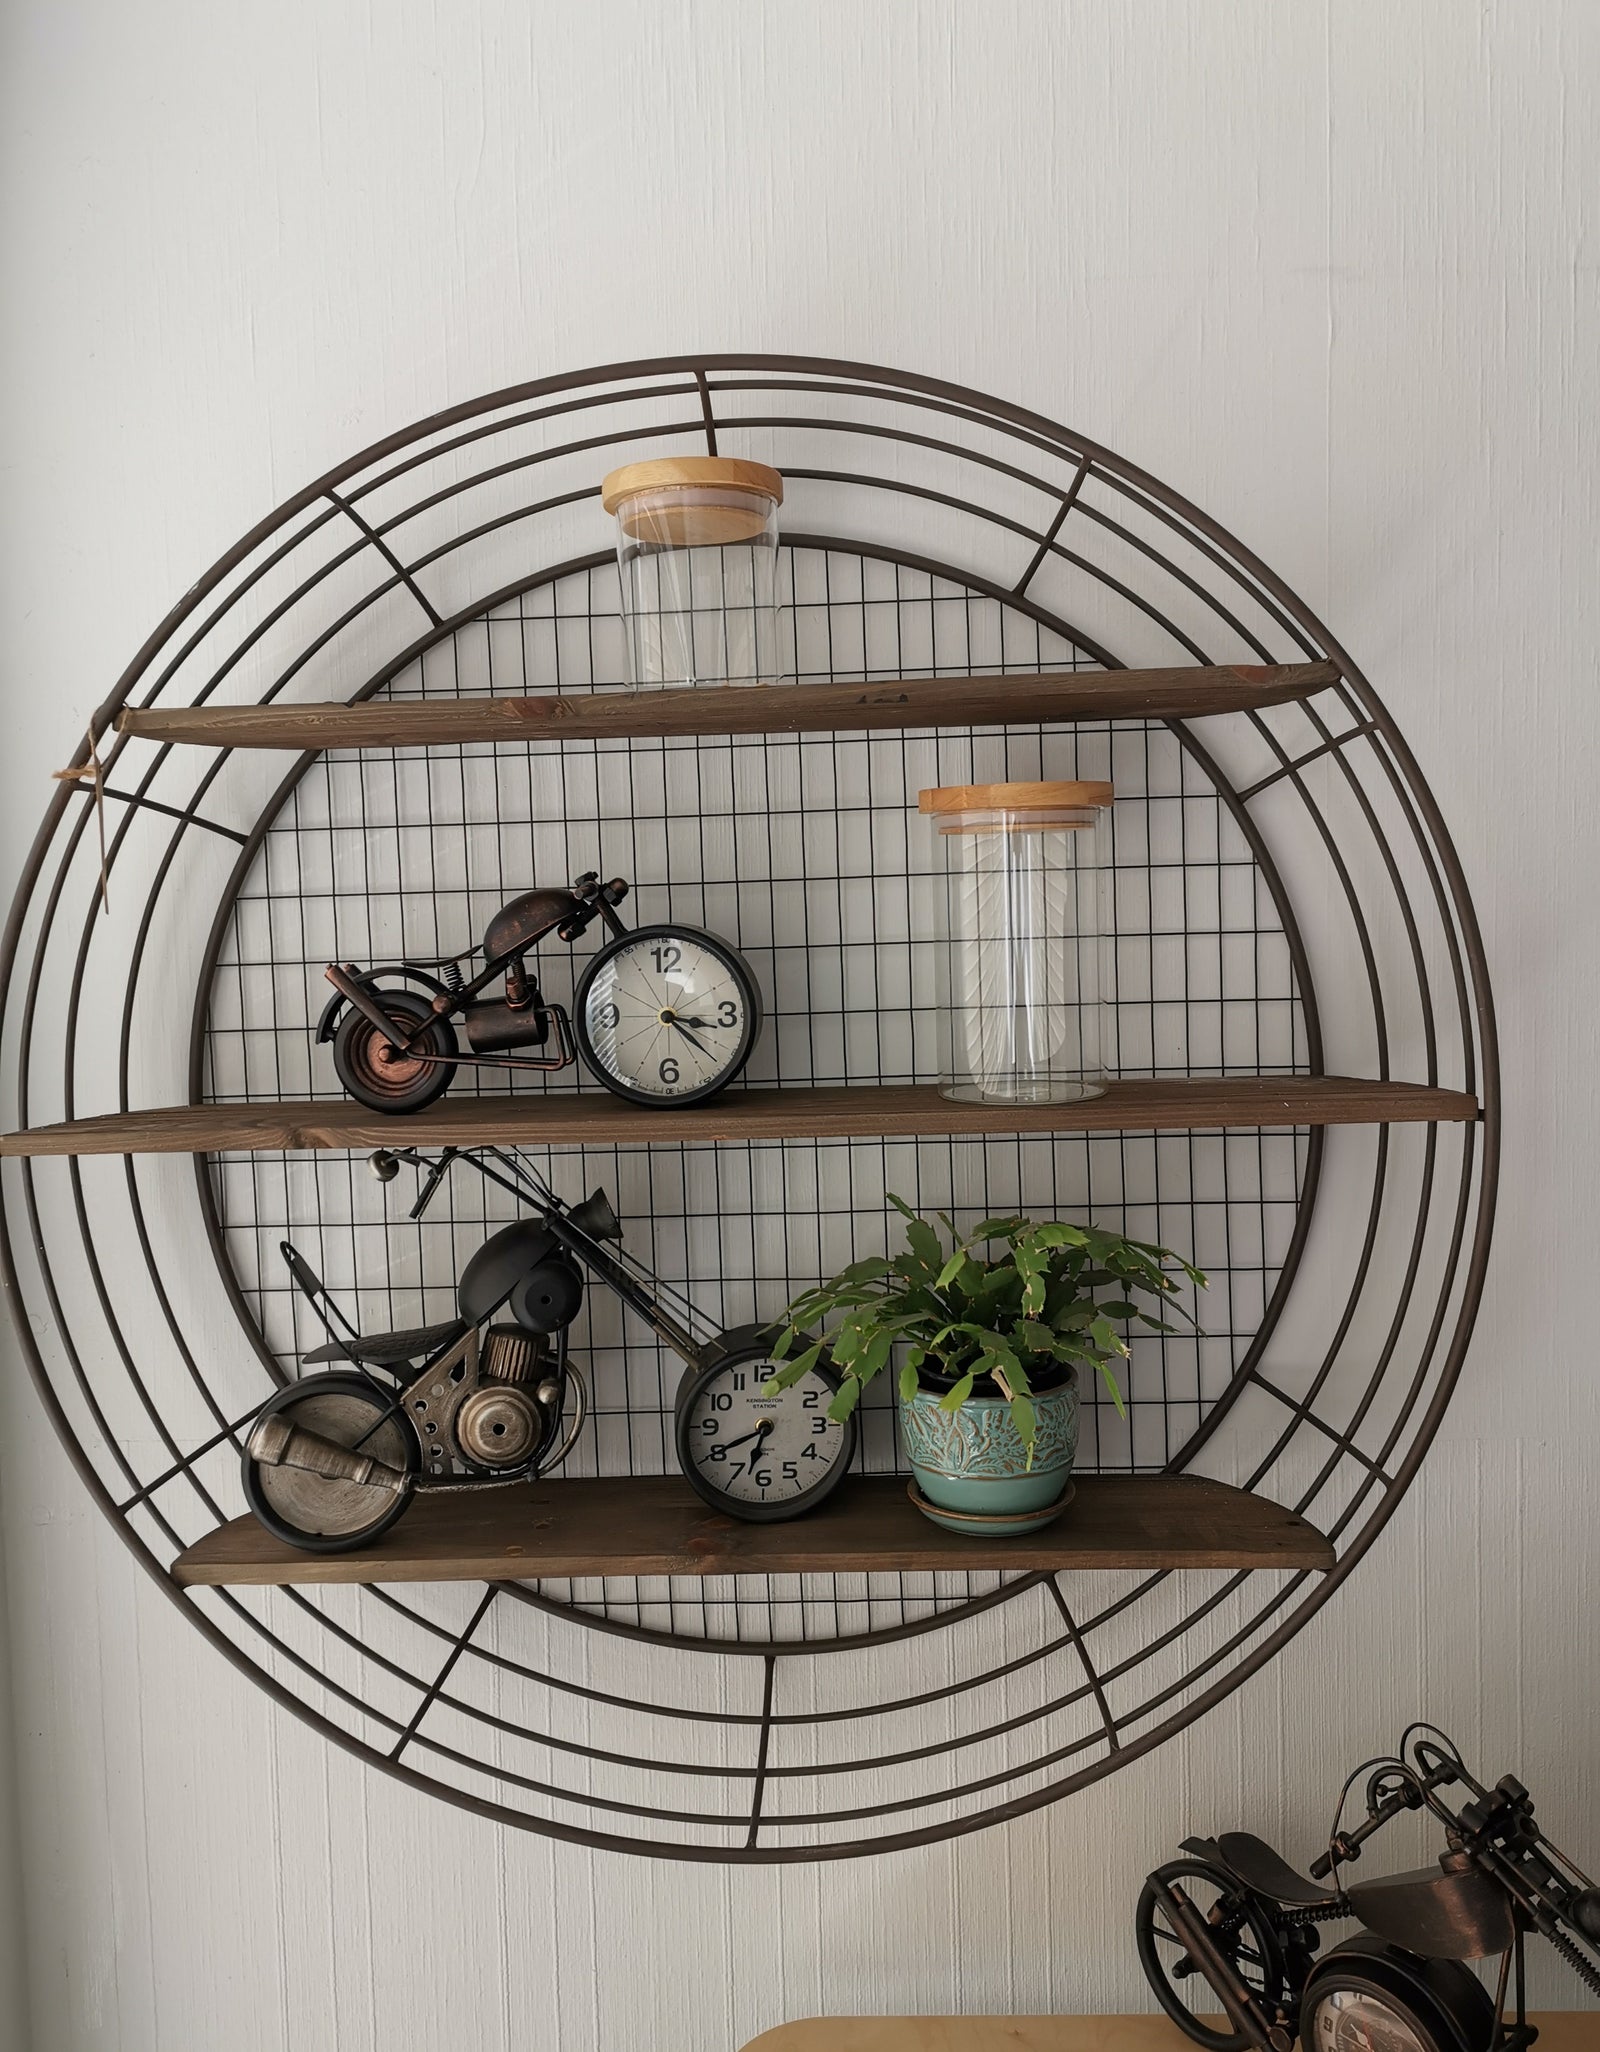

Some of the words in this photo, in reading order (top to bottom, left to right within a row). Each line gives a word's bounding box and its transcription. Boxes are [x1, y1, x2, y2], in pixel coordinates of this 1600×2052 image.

[650, 946, 682, 973] 12
[599, 1002, 620, 1029] 9
[717, 1001, 737, 1028] 3
[659, 1057, 680, 1085] 6
[733, 1373, 745, 1390] 11
[754, 1365, 776, 1382] 12
[711, 1393, 732, 1411] 10
[803, 1391, 819, 1408] 2
[702, 1418, 719, 1436] 9
[812, 1416, 827, 1434] 3
[710, 1444, 727, 1462] 8
[801, 1443, 817, 1460] 4
[730, 1462, 746, 1480] 7
[755, 1469, 772, 1487] 6
[782, 1461, 798, 1479] 5
[1323, 2016, 1333, 2033] 9
